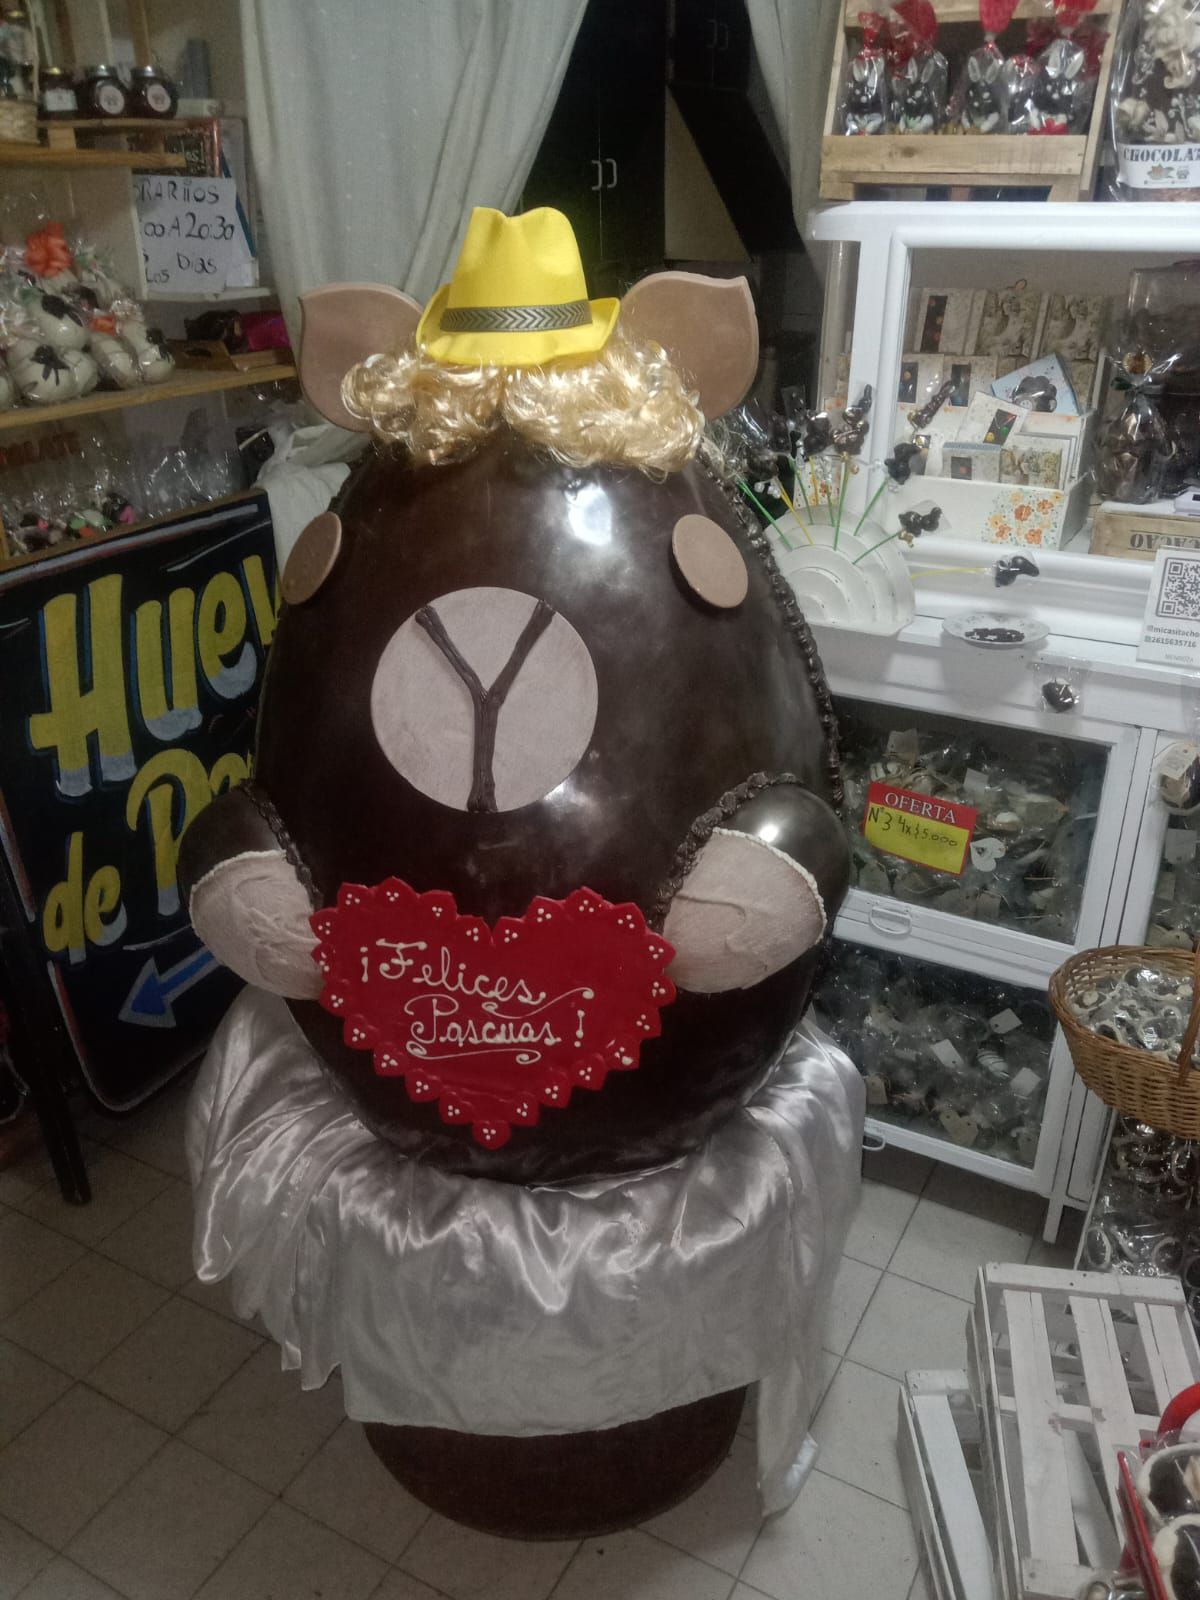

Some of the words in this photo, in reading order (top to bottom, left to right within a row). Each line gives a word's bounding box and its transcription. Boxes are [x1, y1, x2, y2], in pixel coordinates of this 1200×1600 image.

[185, 211, 235, 240] 20:30
[885, 792, 956, 824] OFERTA
[43, 831, 128, 965] de
